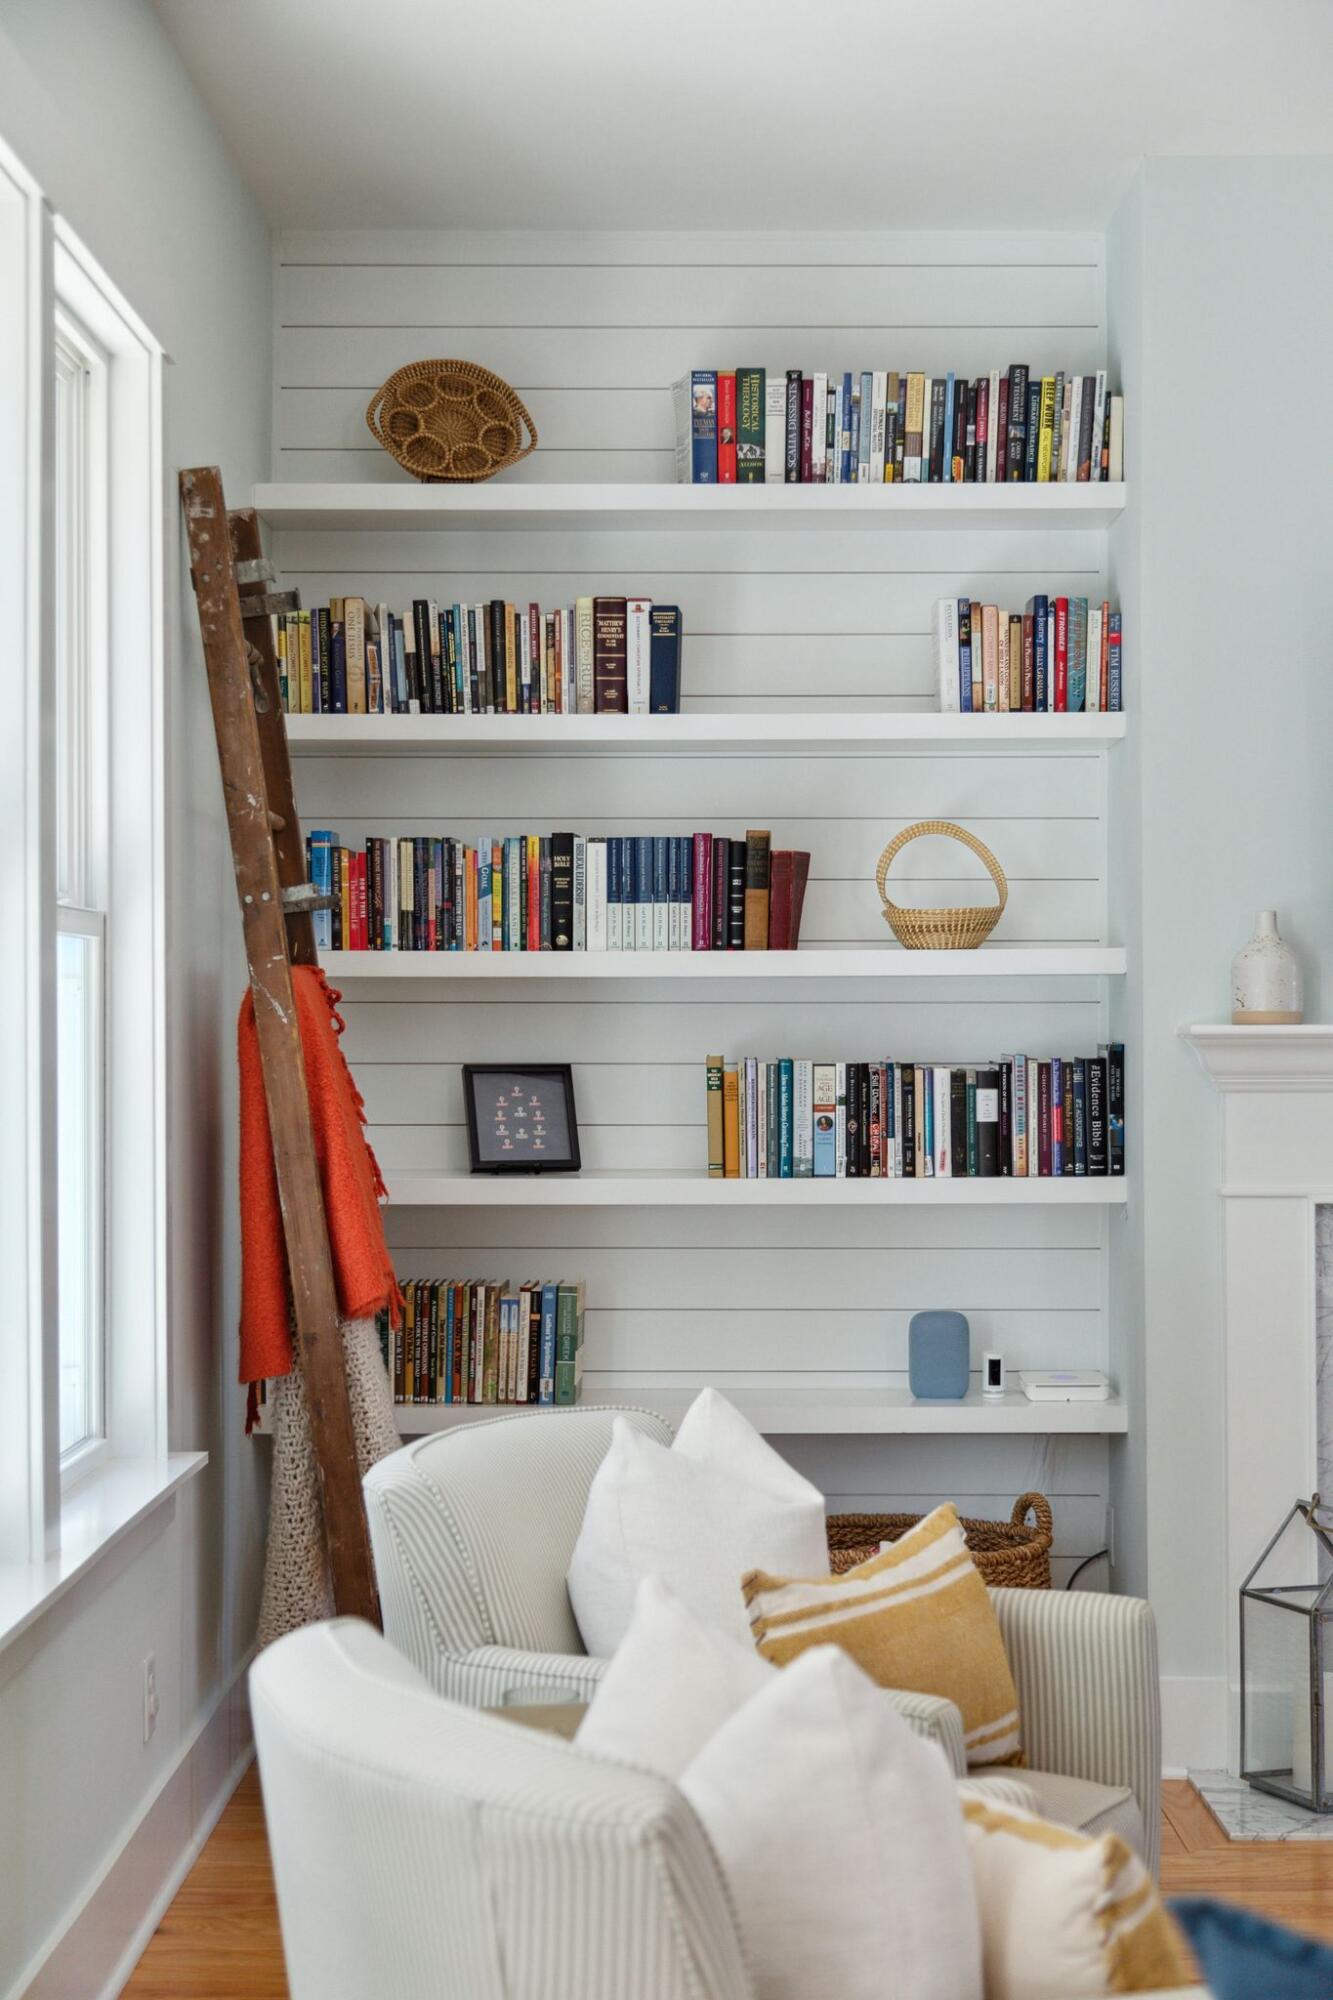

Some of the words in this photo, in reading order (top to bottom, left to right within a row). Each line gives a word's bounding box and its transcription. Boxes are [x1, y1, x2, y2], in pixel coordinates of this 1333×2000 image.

[742, 378, 750, 429] THEOLOGY
[751, 375, 760, 432] HISTORICAL
[1045, 404, 1053, 429] WORK
[788, 433, 796, 467] SCALIA
[347, 612, 356, 631] ONE
[581, 614, 591, 648] RICE
[1036, 618, 1045, 643] Journey
[348, 635, 356, 659] JESUS
[584, 650, 590, 661] TO
[1110, 649, 1118, 668] TIM
[581, 662, 591, 698] RUIN
[1110, 670, 1118, 710] RUSSERT
[575, 843, 584, 871] BIBLICAL
[481, 867, 489, 889] GOAL
[575, 871, 584, 906] ELDERSHIP
[360, 892, 365, 900] TO
[1091, 1070, 1101, 1116] Evidence
[871, 1124, 880, 1152] CHINA
[1092, 1121, 1102, 1147] Bible
[543, 1342, 551, 1377] Spirituality
